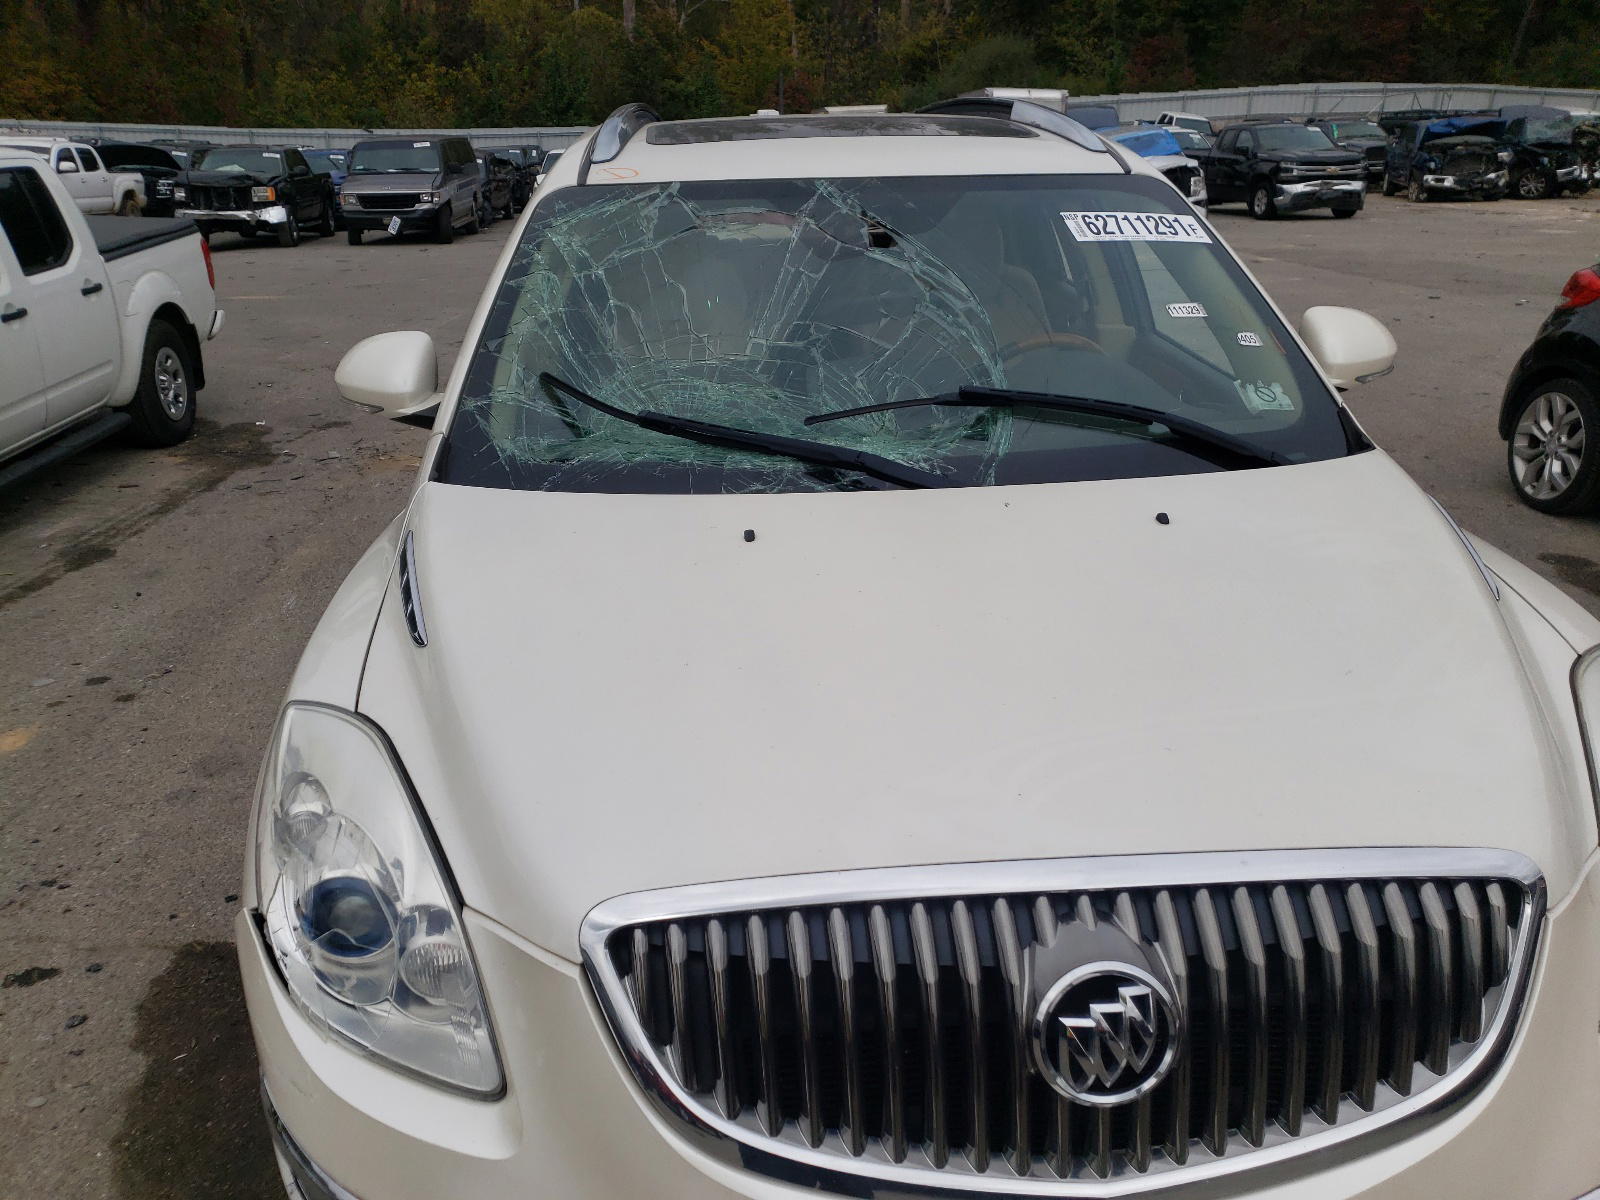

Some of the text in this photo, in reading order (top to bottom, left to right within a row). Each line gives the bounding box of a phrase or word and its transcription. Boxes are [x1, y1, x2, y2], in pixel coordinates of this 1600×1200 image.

[1081, 214, 1191, 236] 62711291
[1187, 223, 1198, 235] F
[1167, 305, 1201, 316] 111329
